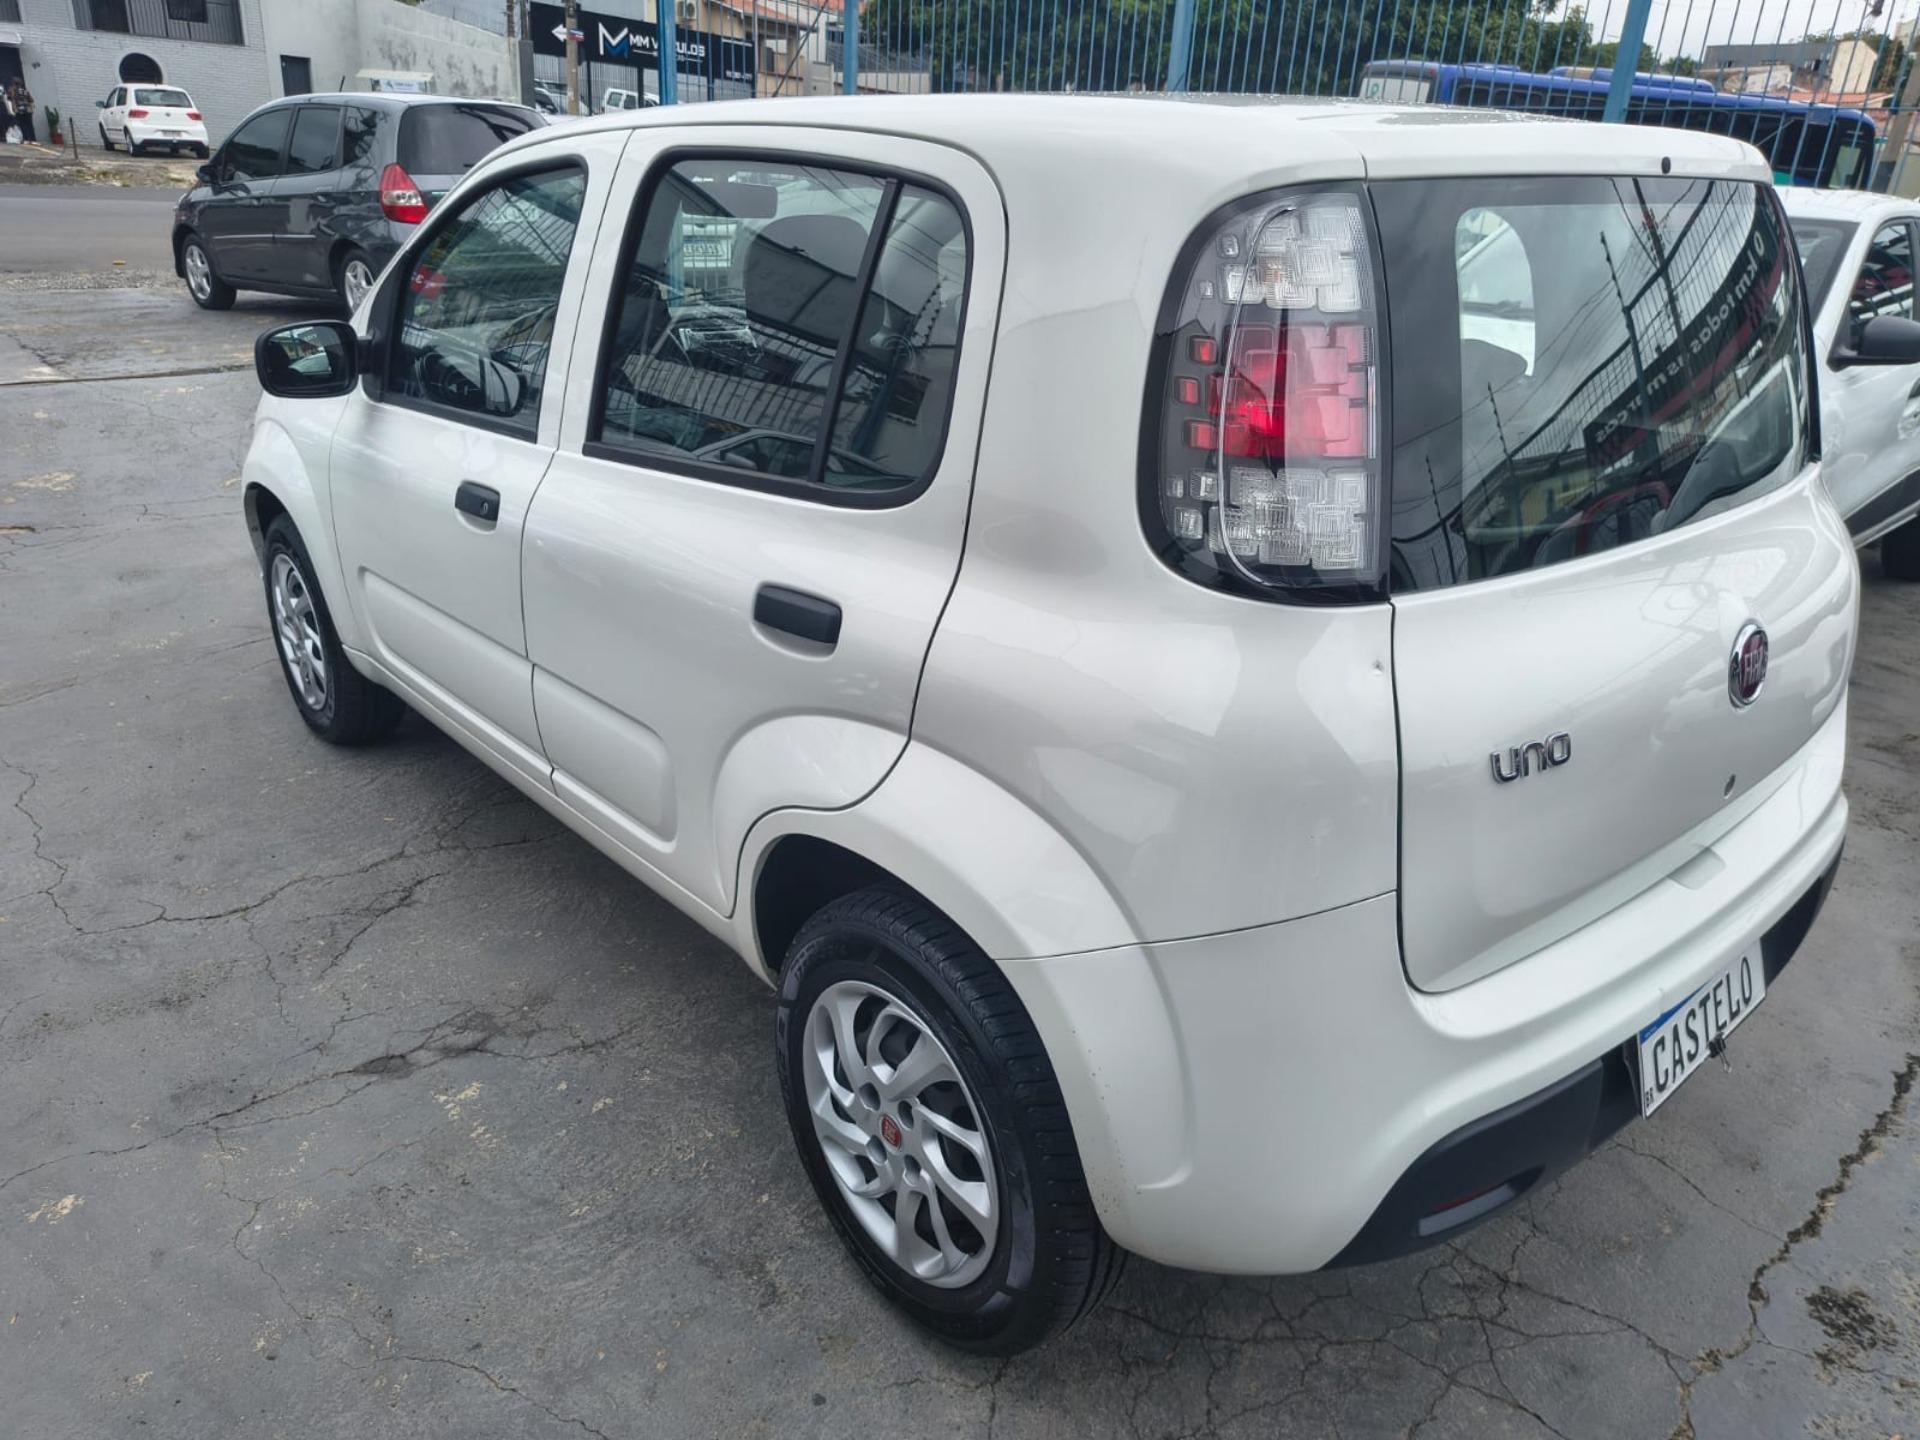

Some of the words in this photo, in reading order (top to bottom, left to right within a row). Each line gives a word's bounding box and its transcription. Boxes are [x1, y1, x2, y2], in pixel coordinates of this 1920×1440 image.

[629, 33, 650, 49] MM
[1490, 731, 1571, 783] uno
[1653, 956, 1753, 1093] CASTELO
